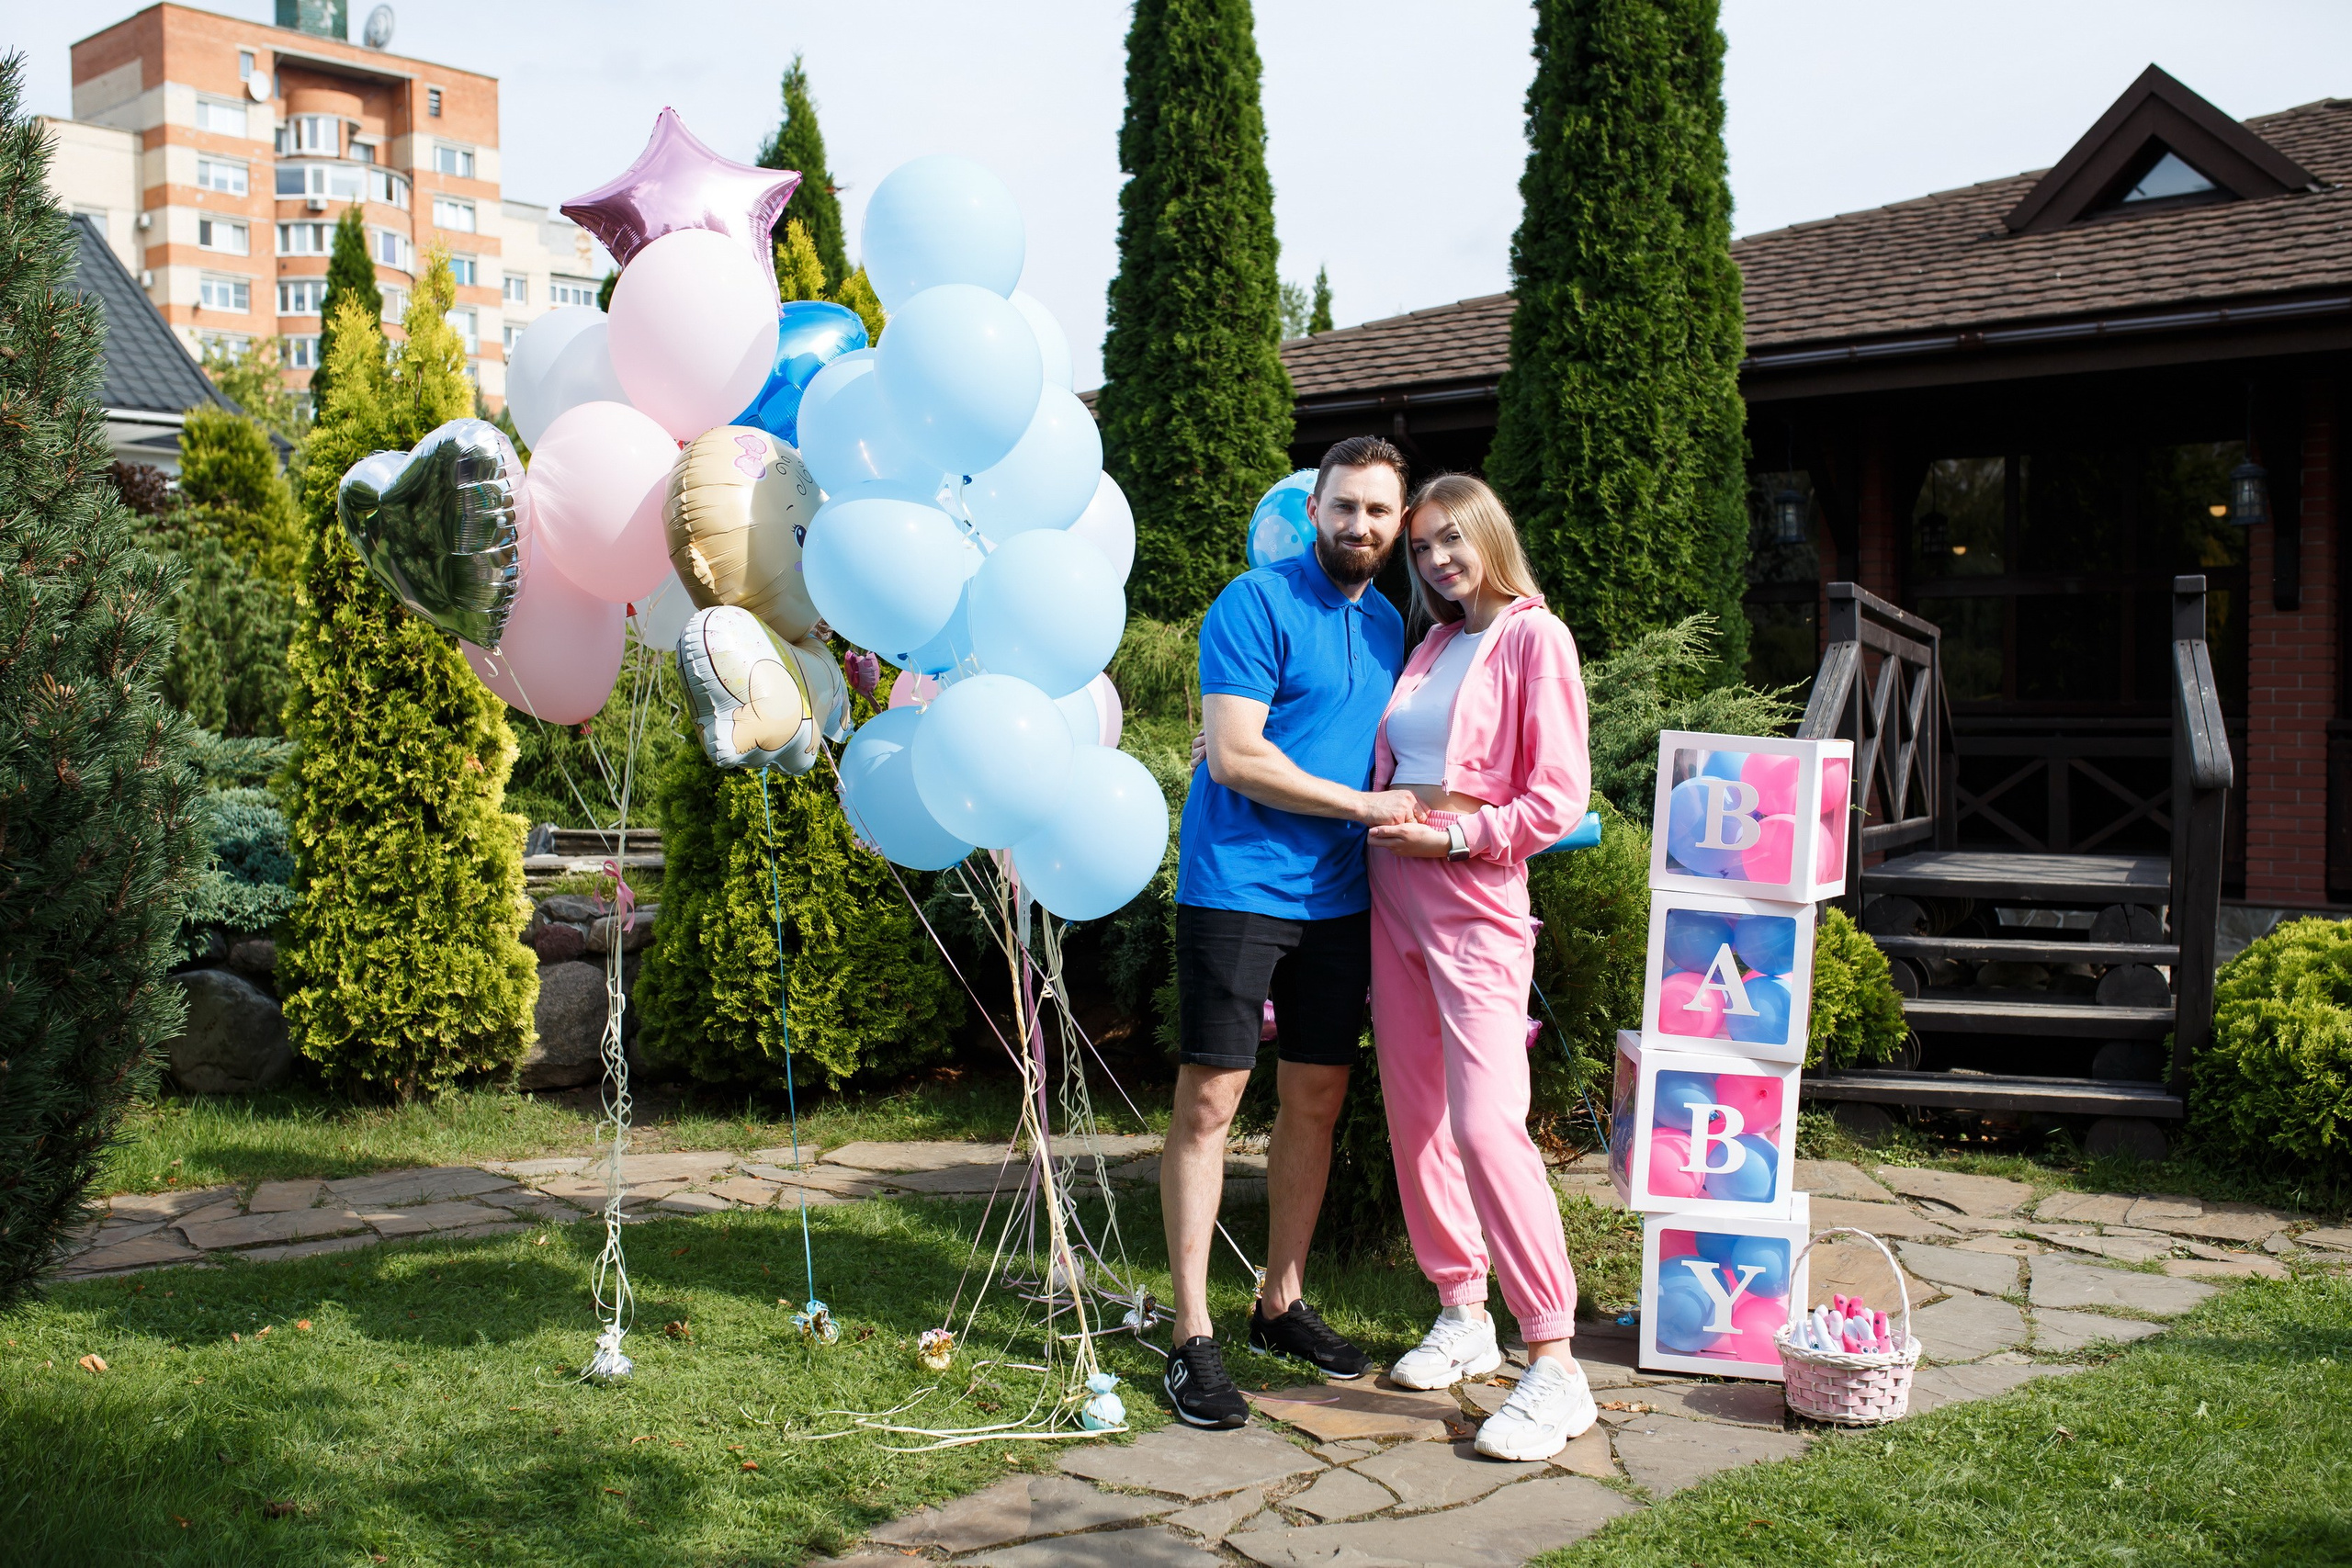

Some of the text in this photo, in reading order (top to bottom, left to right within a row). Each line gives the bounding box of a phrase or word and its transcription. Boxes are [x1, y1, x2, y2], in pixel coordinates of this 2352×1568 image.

[1695, 778, 1761, 851] B
[1682, 942, 1760, 1017] A
[1679, 1102, 1747, 1174] B
[1681, 1259, 1766, 1335] Y
